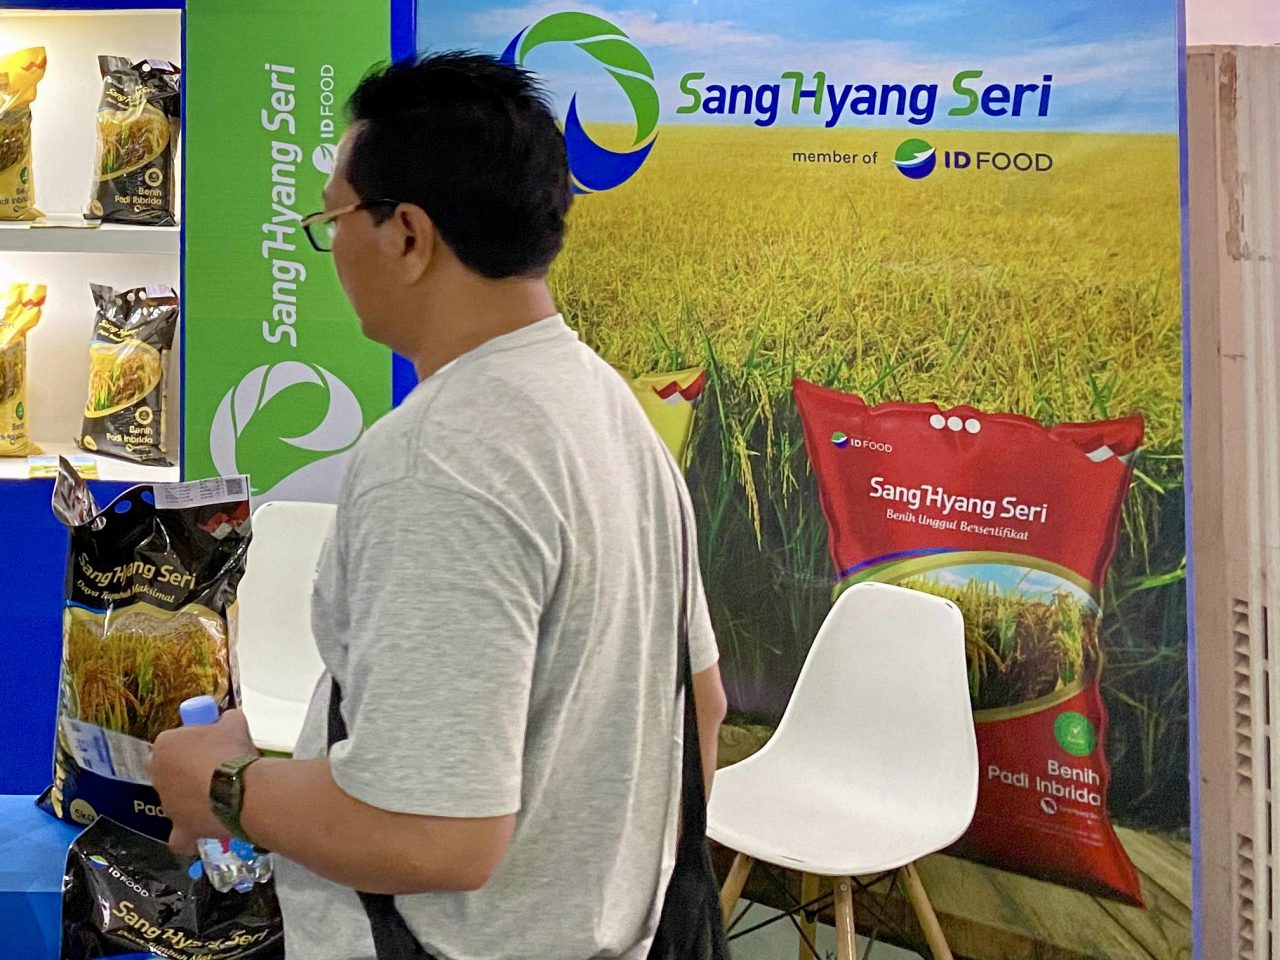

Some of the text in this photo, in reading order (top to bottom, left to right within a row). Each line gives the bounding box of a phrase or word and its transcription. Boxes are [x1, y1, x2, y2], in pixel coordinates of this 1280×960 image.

[321, 64, 334, 138] ID FOOD
[676, 70, 1053, 128] Sang Hyang Seri
[792, 150, 1053, 171] member of ID FOOD
[261, 63, 306, 348] Sang Hyang Seri
[850, 437, 892, 453] ID FOOD
[869, 477, 1048, 523] Sang Hyang Seri
[886, 509, 1028, 541] Benih Unggul Bersertifikat
[79, 552, 113, 586] Sang
[157, 565, 196, 589] Seri
[988, 765, 1101, 806] Padi Inbrida
[1047, 759, 1100, 785] Benih
[108, 866, 149, 897] ID FOOD
[112, 901, 162, 938] Sang
